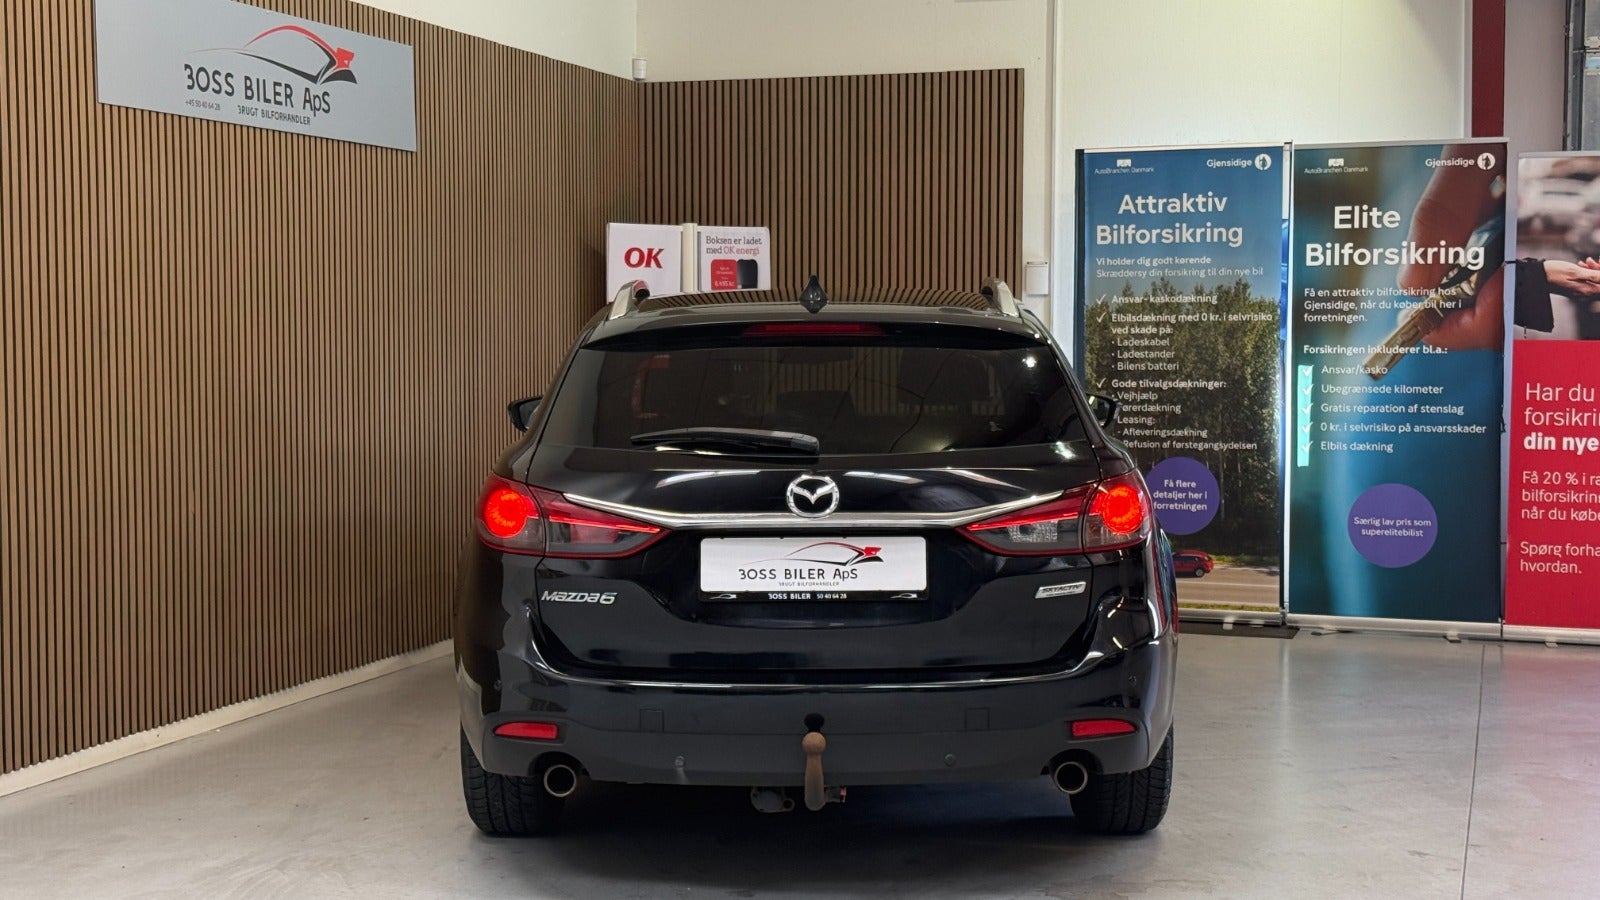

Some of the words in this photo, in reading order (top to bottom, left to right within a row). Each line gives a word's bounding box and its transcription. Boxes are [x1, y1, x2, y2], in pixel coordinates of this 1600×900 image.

[244, 75, 294, 108] BILER
[302, 88, 331, 117] ApS
[261, 108, 311, 125] BILFORHANDLER
[1207, 159, 1252, 168] Gjensidige
[1425, 159, 1475, 168] Gjensidige
[1118, 192, 1227, 215] Attraktiv
[1334, 205, 1400, 229] Elite
[1096, 222, 1243, 247] Bilforsikring
[706, 236, 732, 244] Boksen
[743, 237, 762, 245] ladet
[736, 247, 760, 256] energi
[1305, 240, 1485, 270] Bilforsikring
[624, 247, 664, 269] OK
[1107, 257, 1134, 265] holder
[1137, 257, 1150, 267] dig
[1153, 257, 1173, 267] godt
[1175, 256, 1211, 264] kørende
[1096, 269, 1147, 278] Skræddersy
[1149, 269, 1163, 277] din
[1165, 268, 1206, 278] forsikring
[1207, 268, 1217, 276] til
[1234, 269, 1250, 277] nye
[1252, 267, 1263, 275] bil
[1304, 289, 1316, 297] Få
[1332, 289, 1374, 297] attraktiv
[1376, 288, 1436, 297] bilforsikring
[1438, 288, 1456, 296] hos
[1112, 296, 1148, 304] Ansvar-
[1150, 294, 1217, 304] kaskodækning
[1304, 301, 1358, 311] Gjensidige,
[1360, 301, 1376, 309] når
[1378, 301, 1392, 309] du
[1394, 300, 1422, 309] køber
[1424, 300, 1437, 309] bil
[1439, 300, 1456, 309] her
[1458, 300, 1462, 308] i
[1112, 313, 1176, 323] Elbilsdækning
[1178, 314, 1199, 322] med
[1201, 313, 1208, 321] 0
[1210, 313, 1221, 321] kr.
[1228, 313, 1272, 321] selvrisiko
[1304, 313, 1367, 322] forretningen.
[1112, 326, 1129, 334] ved
[1131, 326, 1157, 334] skade
[1159, 326, 1173, 335] på:
[1117, 338, 1170, 346] Ladeskabel
[1117, 350, 1175, 358] Ladestander
[1303, 345, 1365, 355] Forsikringen
[1368, 345, 1420, 354] inkluderer
[1423, 345, 1448, 354] bl.a.:
[1117, 362, 1146, 371] Bilens
[1148, 362, 1179, 371] batteri
[1321, 365, 1388, 375] Ansvar/kasko
[1112, 379, 1137, 388] Gode
[1139, 379, 1226, 389] tilvalgsdækninger:
[1321, 385, 1392, 395] Ubegrænsede
[1394, 385, 1444, 394] kilometer
[1526, 382, 1563, 401] Har
[1569, 384, 1595, 402] du
[1117, 391, 1158, 401] Vejhjælp
[1321, 403, 1351, 413] Gratis
[1354, 404, 1405, 414] reparation
[1408, 404, 1418, 413] af
[1420, 404, 1464, 415] stenslag
[1117, 416, 1155, 425] Leasing:
[1524, 407, 1600, 426] forsikri
[1122, 428, 1208, 438] Afleveringsdækning
[1320, 423, 1327, 432] 0
[1330, 423, 1342, 432] kr.
[1349, 423, 1396, 433] selvrisiko
[1399, 423, 1411, 434] på
[1414, 424, 1487, 434] ansvarsskader
[1123, 440, 1160, 449] Refusion
[1161, 440, 1171, 449] af
[1173, 440, 1258, 451] førstegangsydelsen
[1321, 442, 1347, 451] Elbils
[1350, 442, 1393, 453] dækning
[1523, 432, 1556, 450] din
[1562, 435, 1599, 455] nye
[1164, 479, 1174, 488] Få
[1176, 479, 1196, 488] flere
[1522, 471, 1539, 484] Få
[1543, 472, 1561, 485] 20
[1565, 473, 1578, 486] %
[1153, 491, 1187, 500] detaljer
[1188, 491, 1203, 499] her
[1522, 489, 1600, 503] bilforsikrin
[1153, 502, 1207, 511] forretningen
[1521, 507, 1545, 519] når
[1549, 508, 1566, 520] du
[1354, 517, 1381, 527] Særlig
[1382, 518, 1393, 526] lav
[1396, 519, 1411, 527] pris
[1520, 541, 1562, 558] Spørg
[1520, 559, 1582, 574] hvordan.
[785, 569, 825, 579] BILER
[833, 569, 858, 581] ApS
